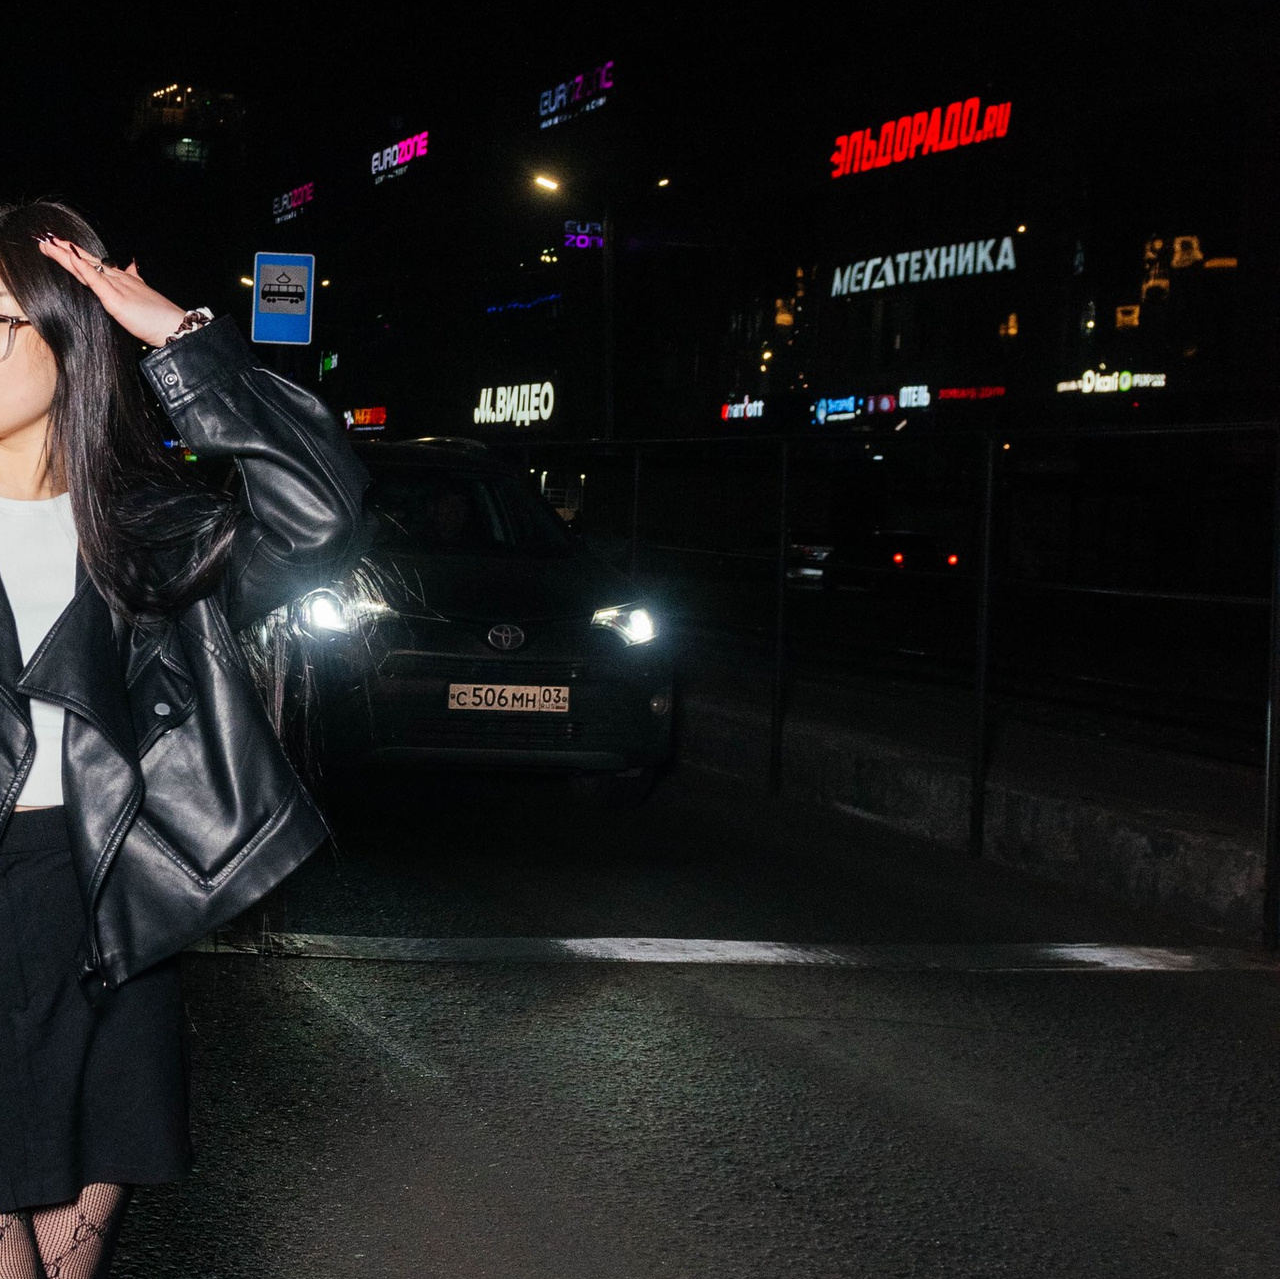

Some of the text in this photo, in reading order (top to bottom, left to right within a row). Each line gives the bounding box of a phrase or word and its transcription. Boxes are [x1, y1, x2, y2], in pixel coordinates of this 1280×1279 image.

[831, 236, 1017, 297] МЕГАТЕХНИКА
[473, 381, 555, 427] М.ВИДЕО
[542, 688, 562, 703] 03
